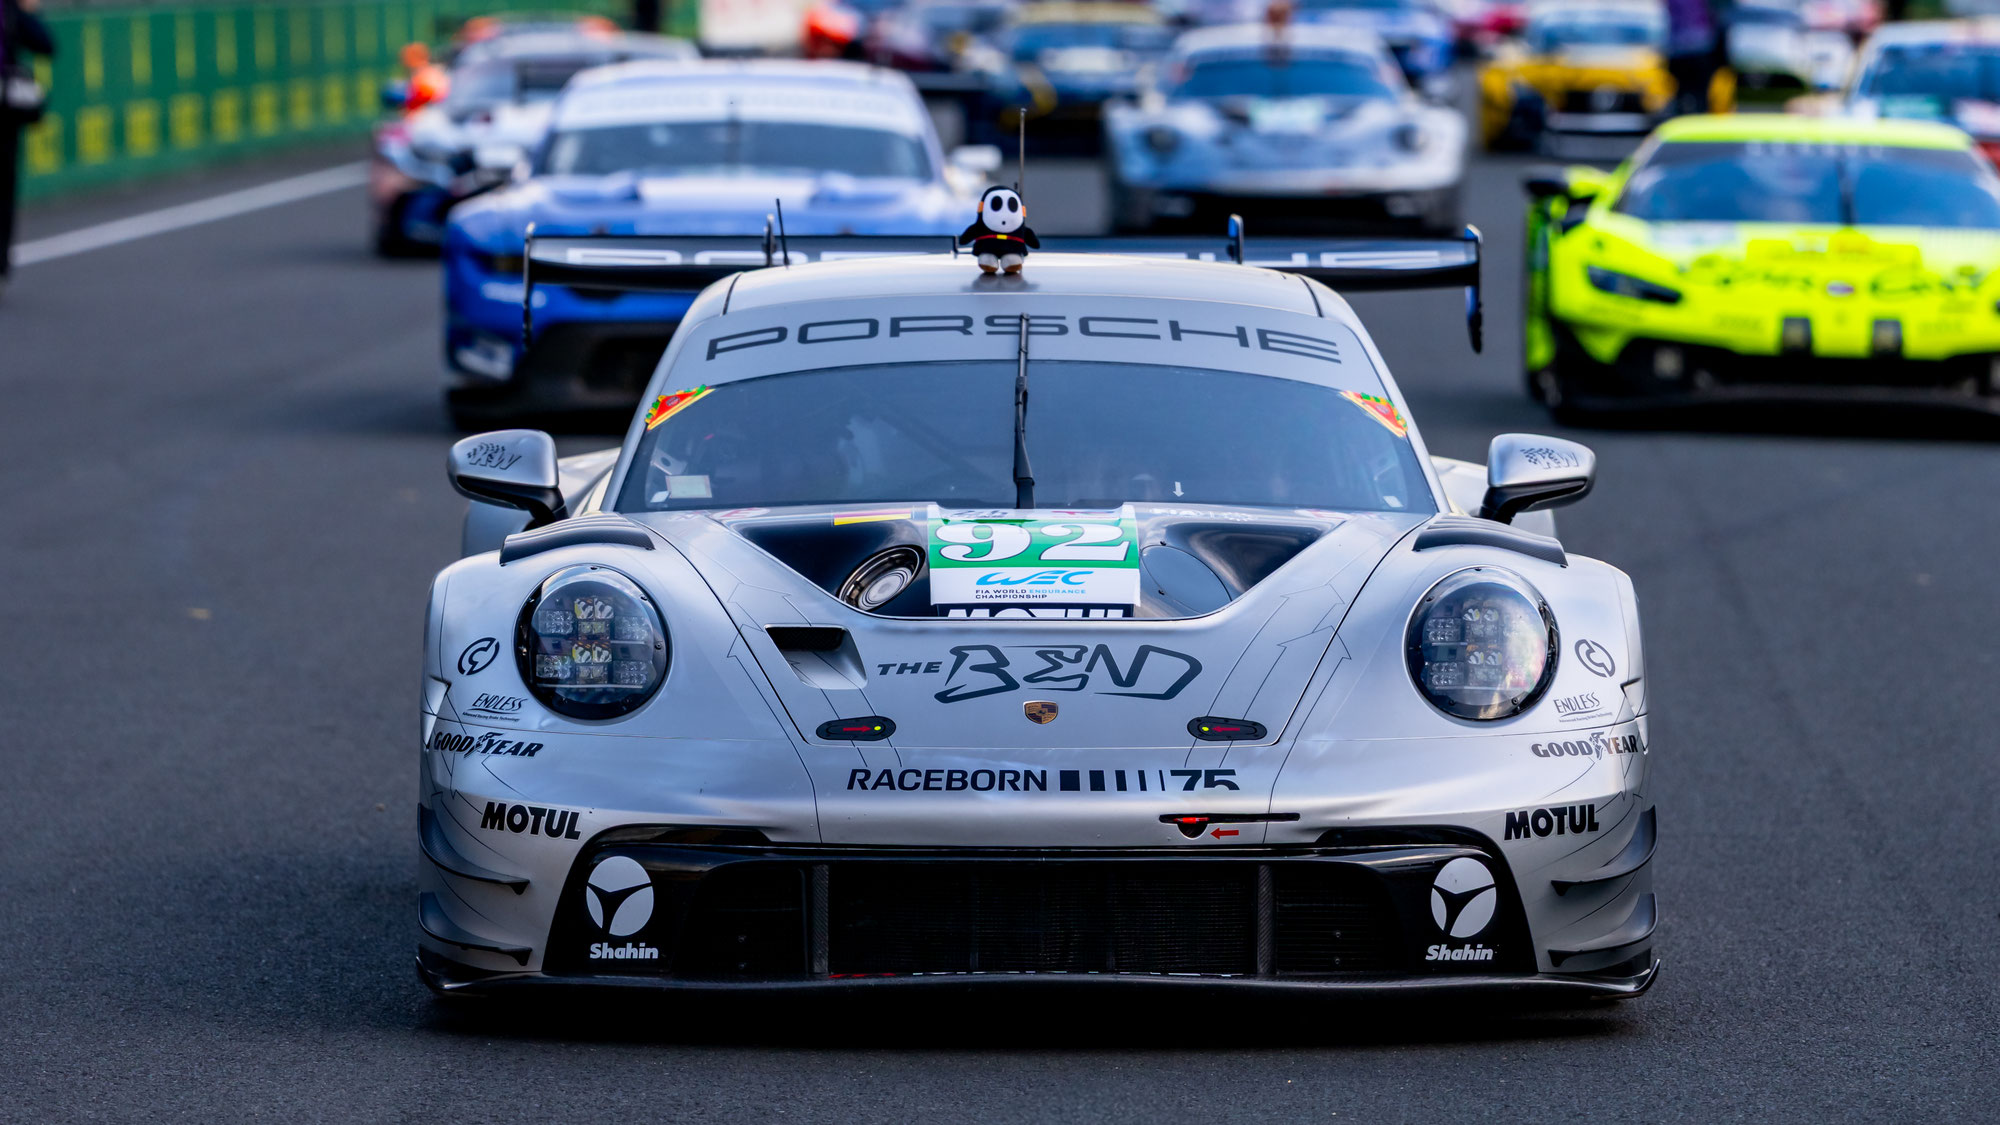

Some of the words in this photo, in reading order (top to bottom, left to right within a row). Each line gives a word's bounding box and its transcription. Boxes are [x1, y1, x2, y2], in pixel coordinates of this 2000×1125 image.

[706, 314, 1343, 364] PORSCHE
[935, 522, 1132, 562] 92
[976, 569, 1095, 586] WEC
[877, 661, 943, 676] THE
[472, 692, 528, 712] ENDLESS
[1553, 691, 1601, 714] ENDLESS
[847, 768, 1048, 791] RACEBORN
[1169, 769, 1240, 791] 75
[481, 801, 582, 841] MOTUL
[1504, 803, 1600, 841] MOTUL
[589, 942, 659, 960] Shahin
[1425, 943, 1494, 961] Shahin
